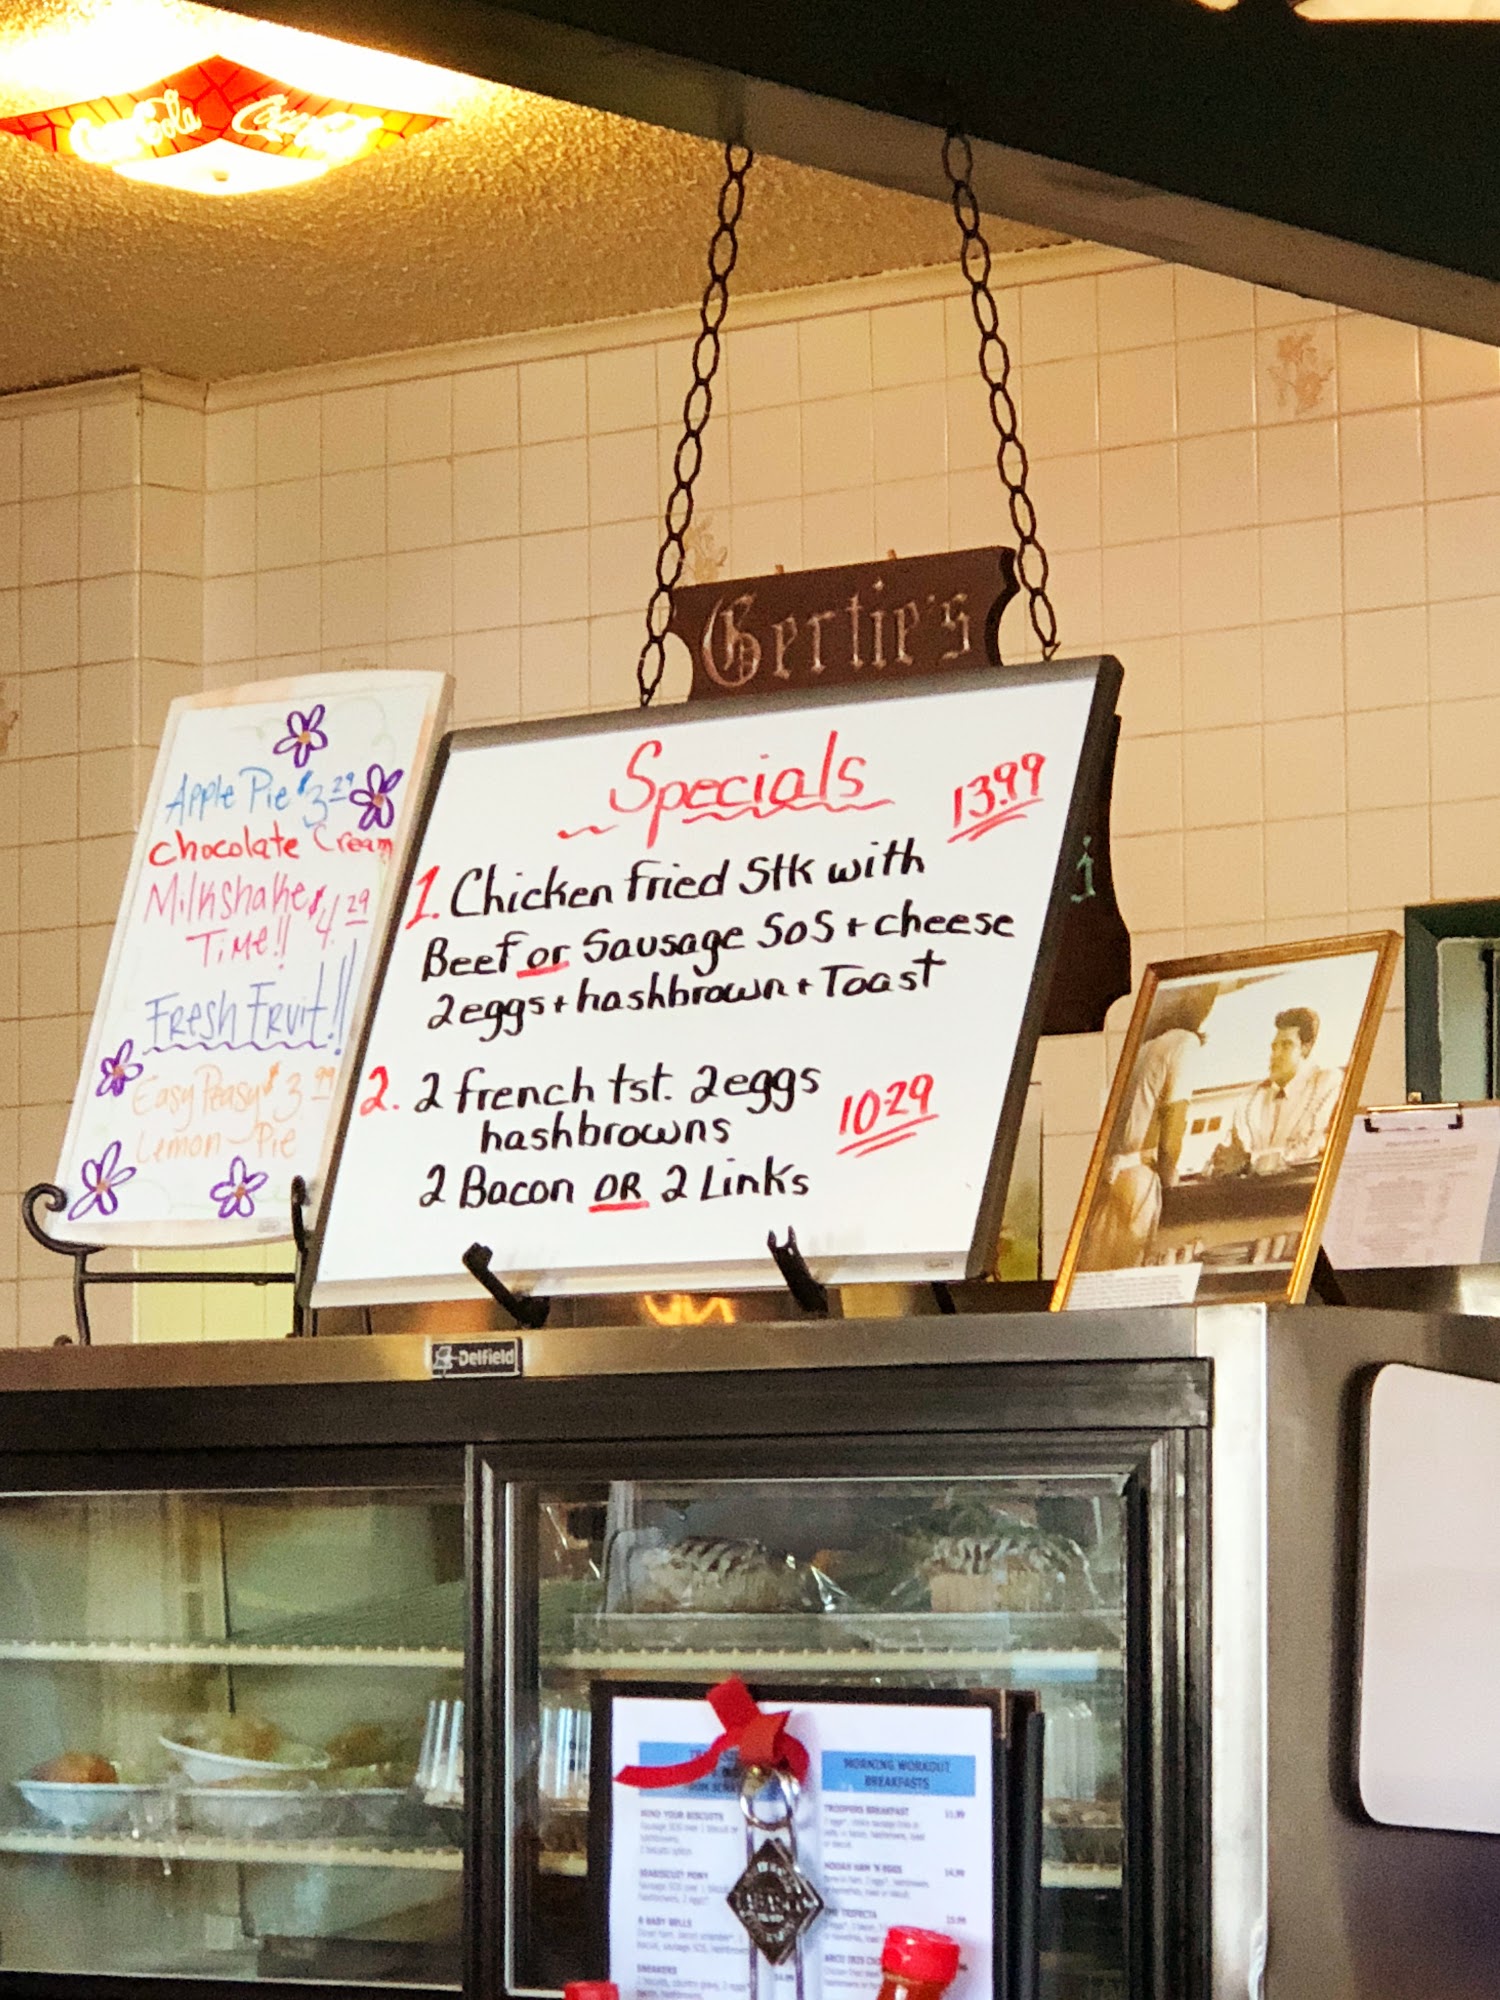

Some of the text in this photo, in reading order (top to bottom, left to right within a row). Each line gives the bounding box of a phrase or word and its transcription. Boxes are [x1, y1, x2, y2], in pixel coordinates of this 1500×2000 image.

[702, 577, 971, 687] Gertie's
[164, 772, 235, 826] Apple
[239, 766, 291, 814] Pie
[609, 731, 867, 849] Specials
[405, 864, 441, 930] 1.
[450, 863, 613, 917] Chicken
[828, 836, 926, 885] with
[421, 931, 529, 982] Beef
[526, 945, 571, 970] or
[583, 928, 745, 978] Sausage
[874, 898, 1016, 938] cheese
[820, 948, 947, 998] Toast
[132, 1074, 195, 1132] Easy
[360, 1065, 400, 1116] 2.
[413, 1072, 443, 1113] 2
[136, 1121, 296, 1164] Lemon Pie
[480, 1109, 731, 1154] hashbrowns
[419, 1163, 446, 1208] 2
[459, 1164, 575, 1208] Bacon
[593, 1171, 643, 1202] OR
[661, 1163, 688, 1204] 2
[458, 1348, 515, 1367] Delfield
[843, 1757, 951, 1774] MORNING WORKOUT
[864, 1775, 931, 1791] BREAKFASTS
[866, 1805, 910, 1817] BREAKFAST
